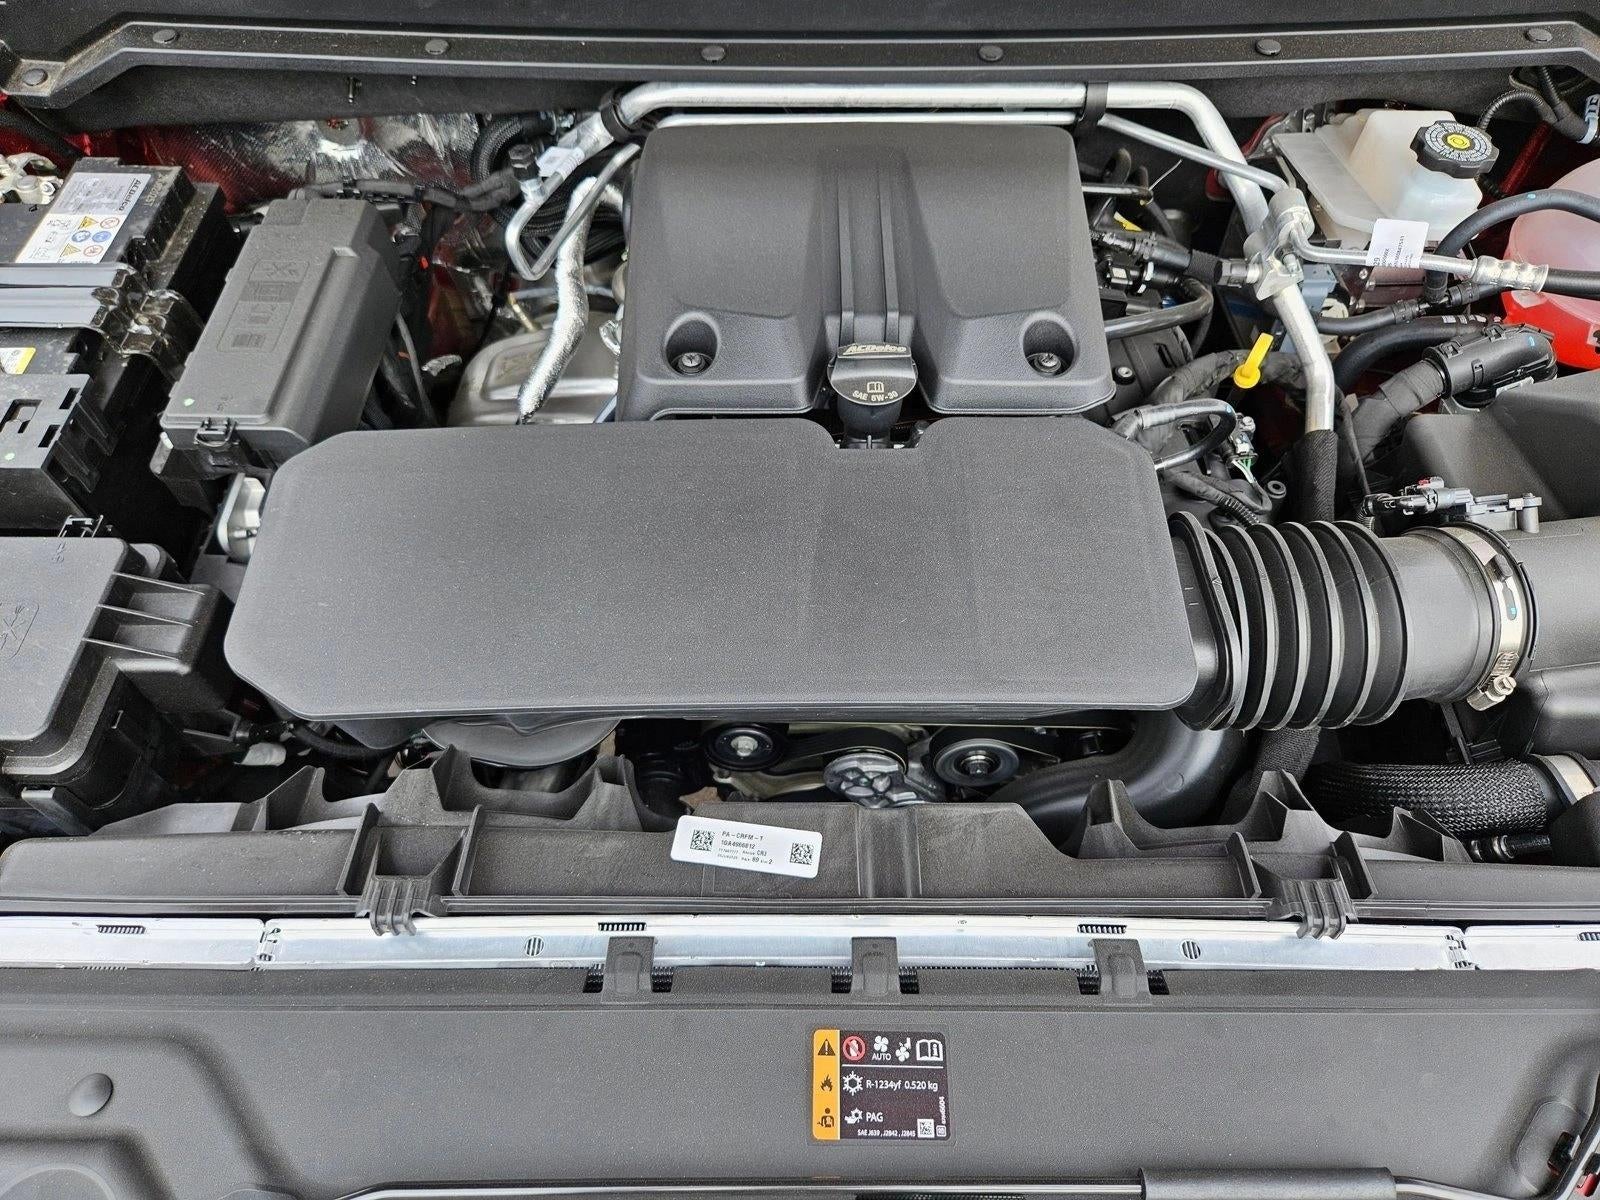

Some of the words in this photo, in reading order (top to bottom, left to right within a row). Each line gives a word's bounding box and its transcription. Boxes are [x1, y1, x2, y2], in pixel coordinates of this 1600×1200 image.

[118, 178, 142, 211] ACDelco
[843, 344, 907, 356] ACDelco
[852, 390, 868, 400] SAE
[872, 1053, 891, 1061] AUTO
[866, 1080, 901, 1091] R-1234yf
[904, 1080, 926, 1089] 0.520
[928, 1080, 938, 1092] kg
[866, 1112, 884, 1122] PAG
